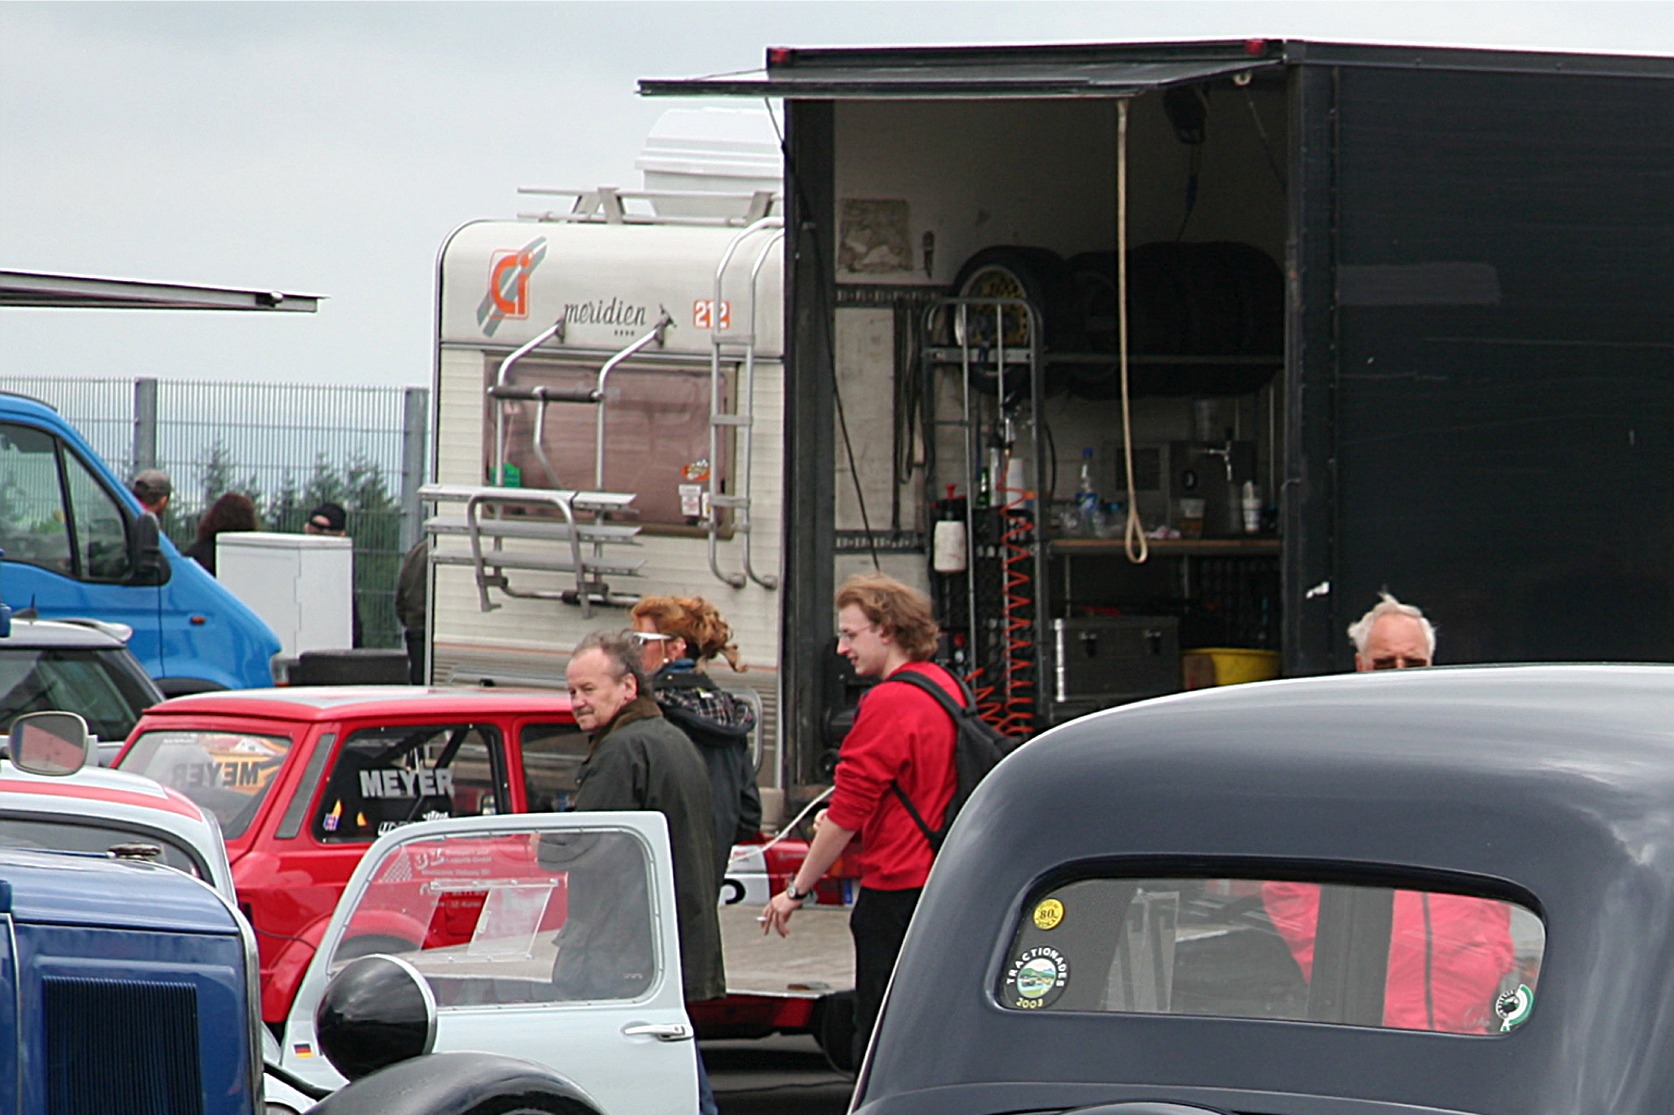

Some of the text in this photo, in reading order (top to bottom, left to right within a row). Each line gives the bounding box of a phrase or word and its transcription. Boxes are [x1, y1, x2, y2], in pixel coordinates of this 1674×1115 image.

[564, 297, 647, 326] meridien
[696, 303, 729, 328] 212
[359, 768, 455, 798] MEYER
[1007, 948, 1067, 987] TRACTIONADES
